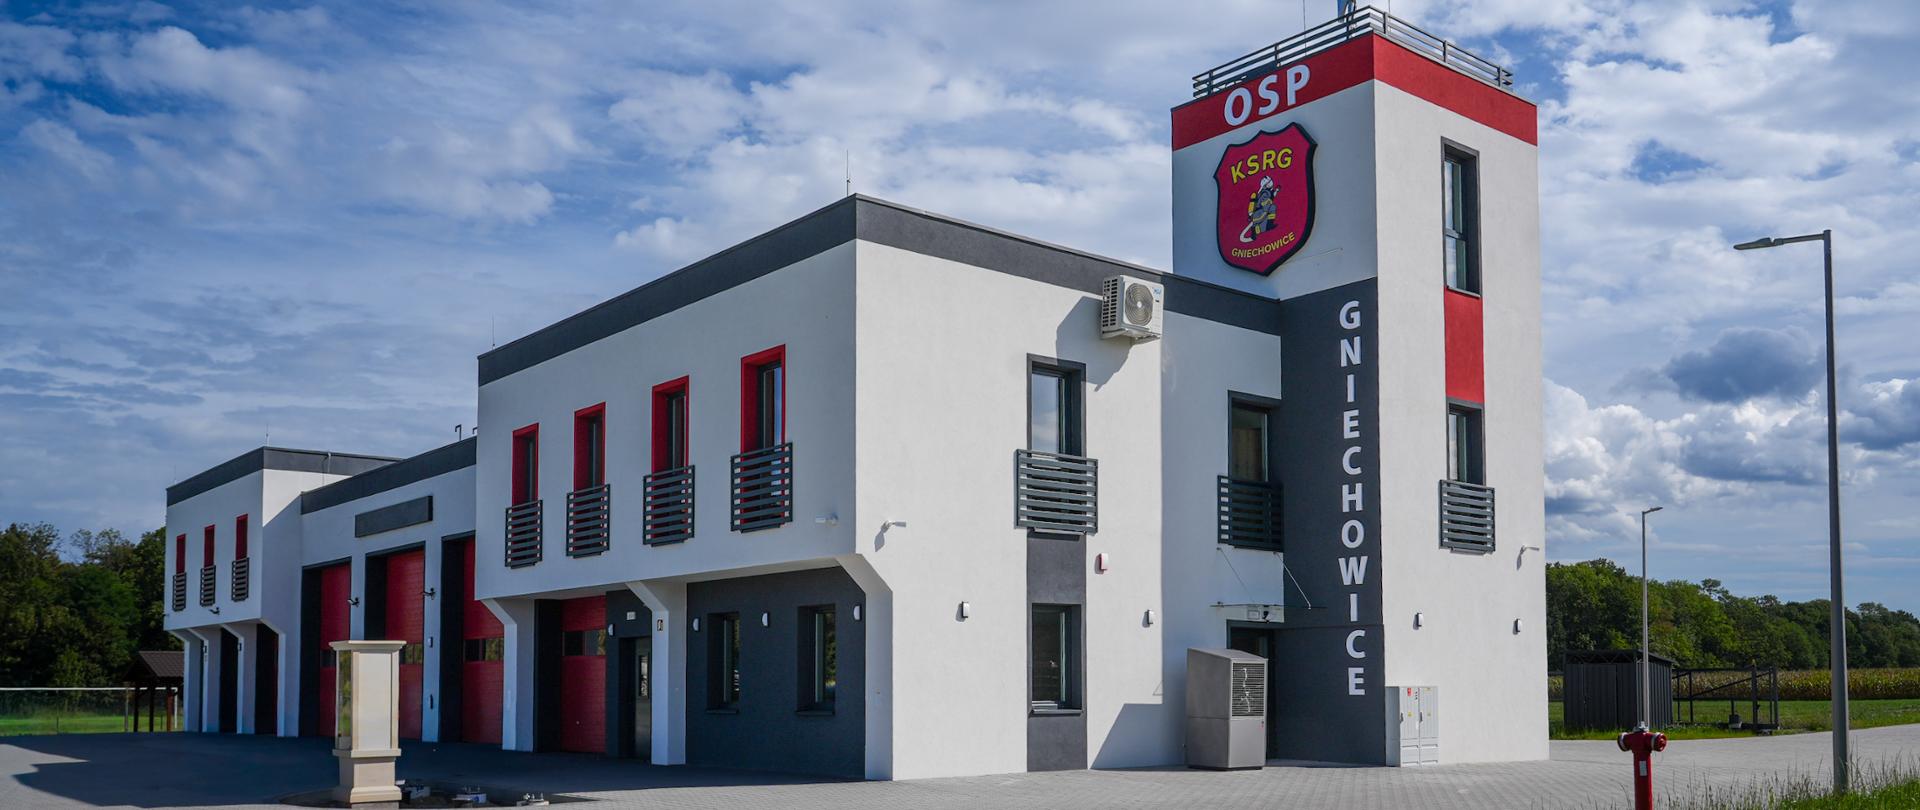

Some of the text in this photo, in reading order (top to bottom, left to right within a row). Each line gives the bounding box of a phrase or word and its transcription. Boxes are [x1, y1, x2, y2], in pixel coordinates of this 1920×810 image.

[1224, 64, 1311, 126] OSP
[1230, 148, 1293, 184] KSRG
[1231, 232, 1295, 258] GNIECHOWICE
[1338, 300, 1368, 696] GNIECHOWICE
